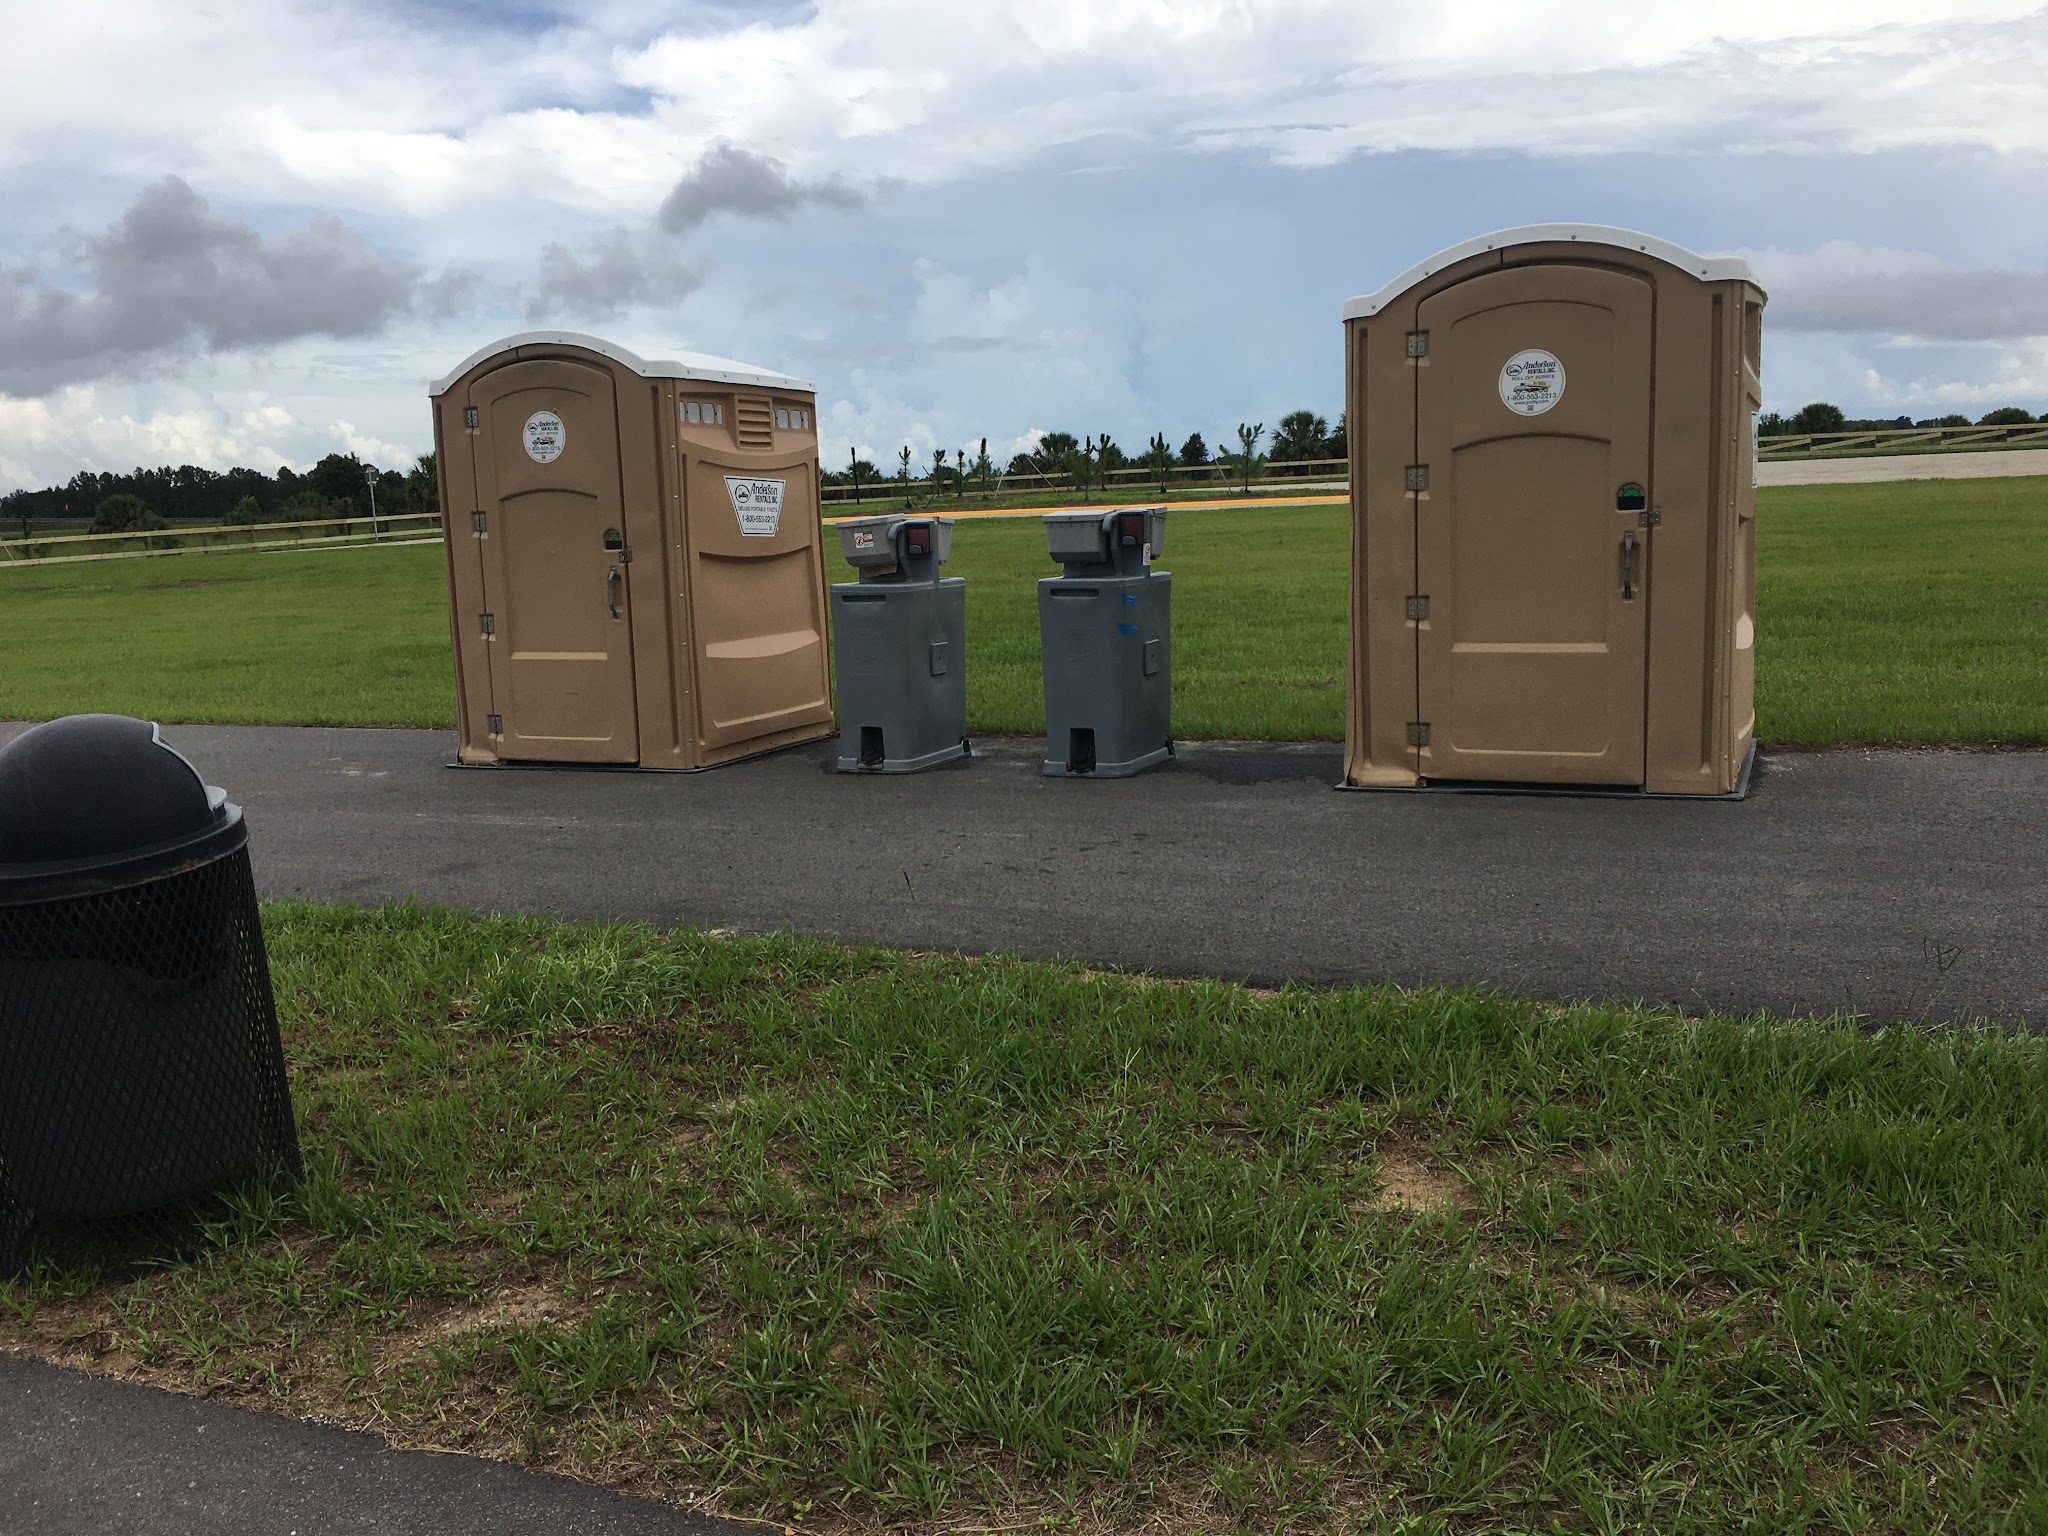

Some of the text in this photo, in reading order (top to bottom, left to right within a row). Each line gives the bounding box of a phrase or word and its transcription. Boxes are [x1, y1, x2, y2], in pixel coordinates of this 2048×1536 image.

[1522, 361, 1556, 370] Anderson
[1507, 393, 1557, 401] 1-800-553-2213
[751, 483, 778, 495] Anderson
[742, 515, 775, 523] 1-800-553-2213
